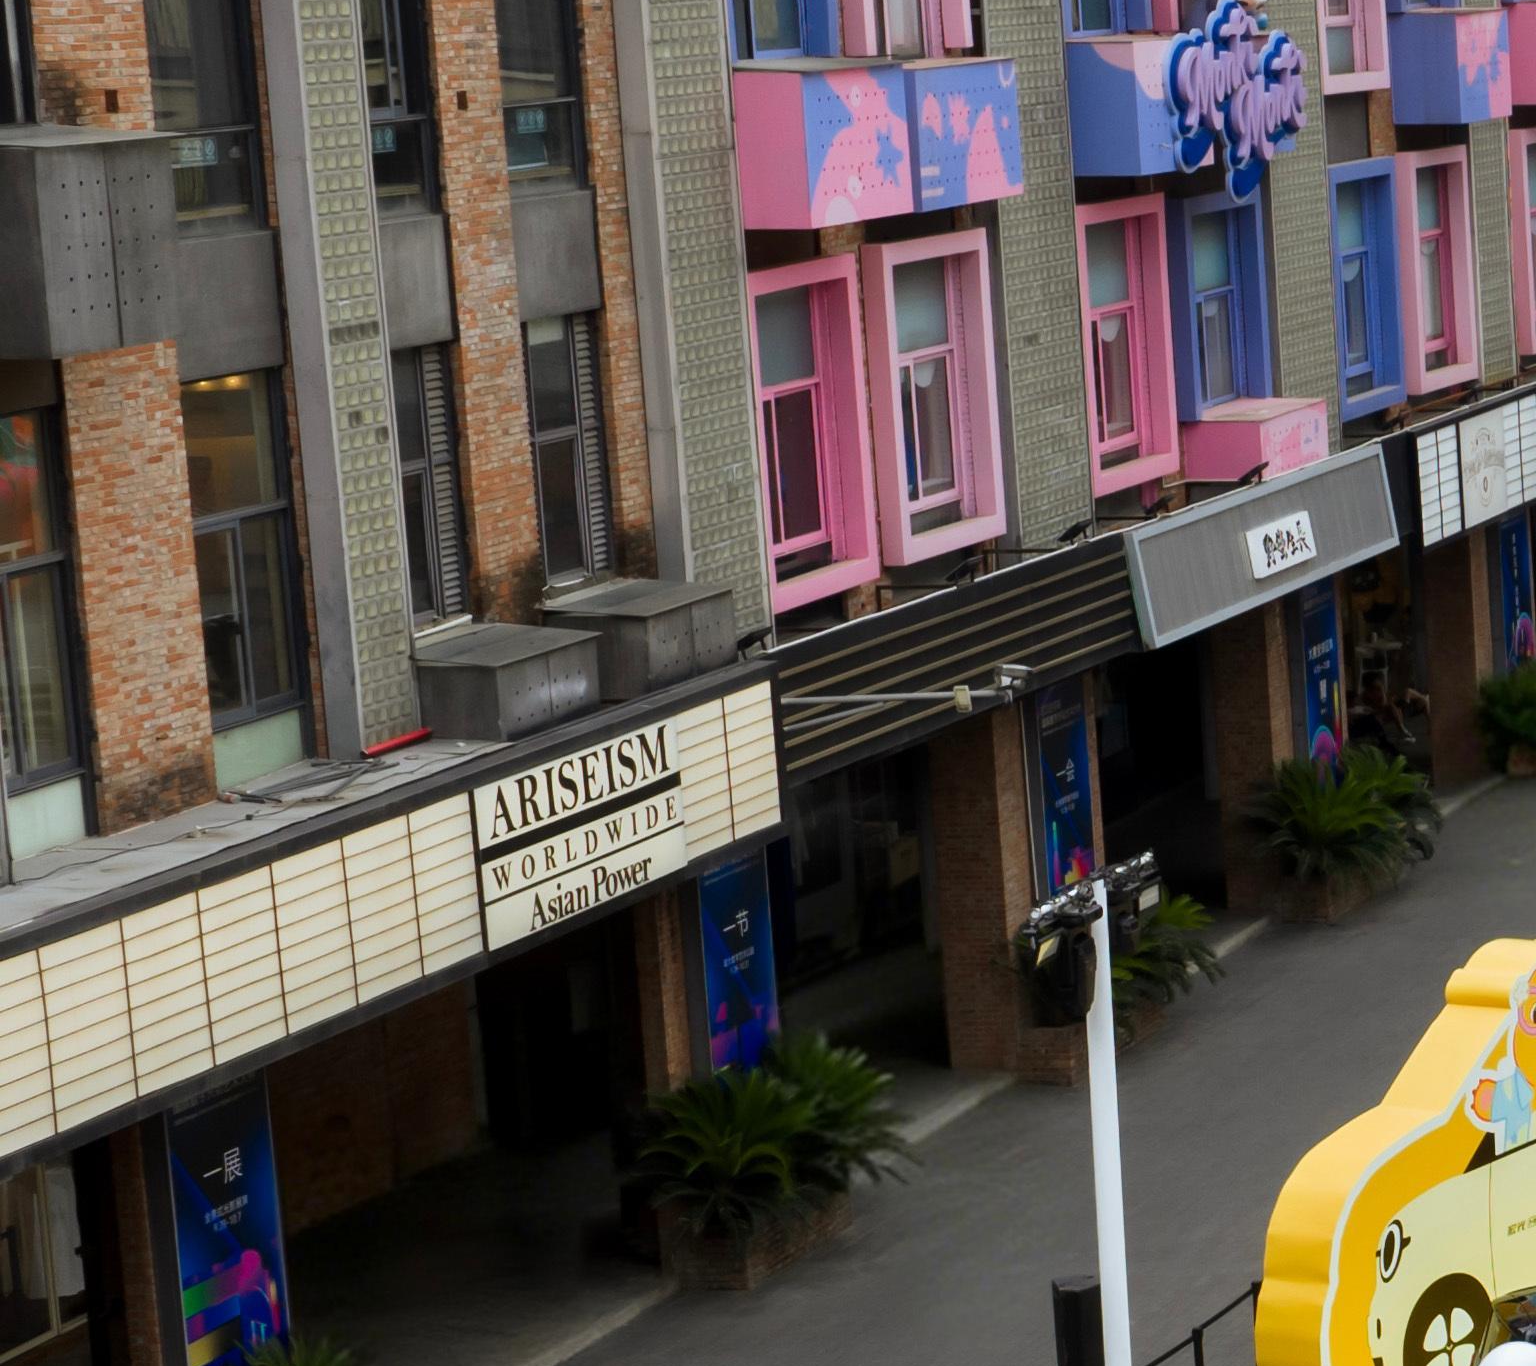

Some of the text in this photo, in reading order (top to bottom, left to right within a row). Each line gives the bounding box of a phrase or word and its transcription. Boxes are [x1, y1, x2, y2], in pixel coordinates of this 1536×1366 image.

[490, 725, 670, 839] ARISEISM
[492, 795, 676, 892] WORLDWIDE
[530, 883, 590, 932] Asian
[592, 857, 652, 905] Power
[203, 1147, 243, 1184] 一展
